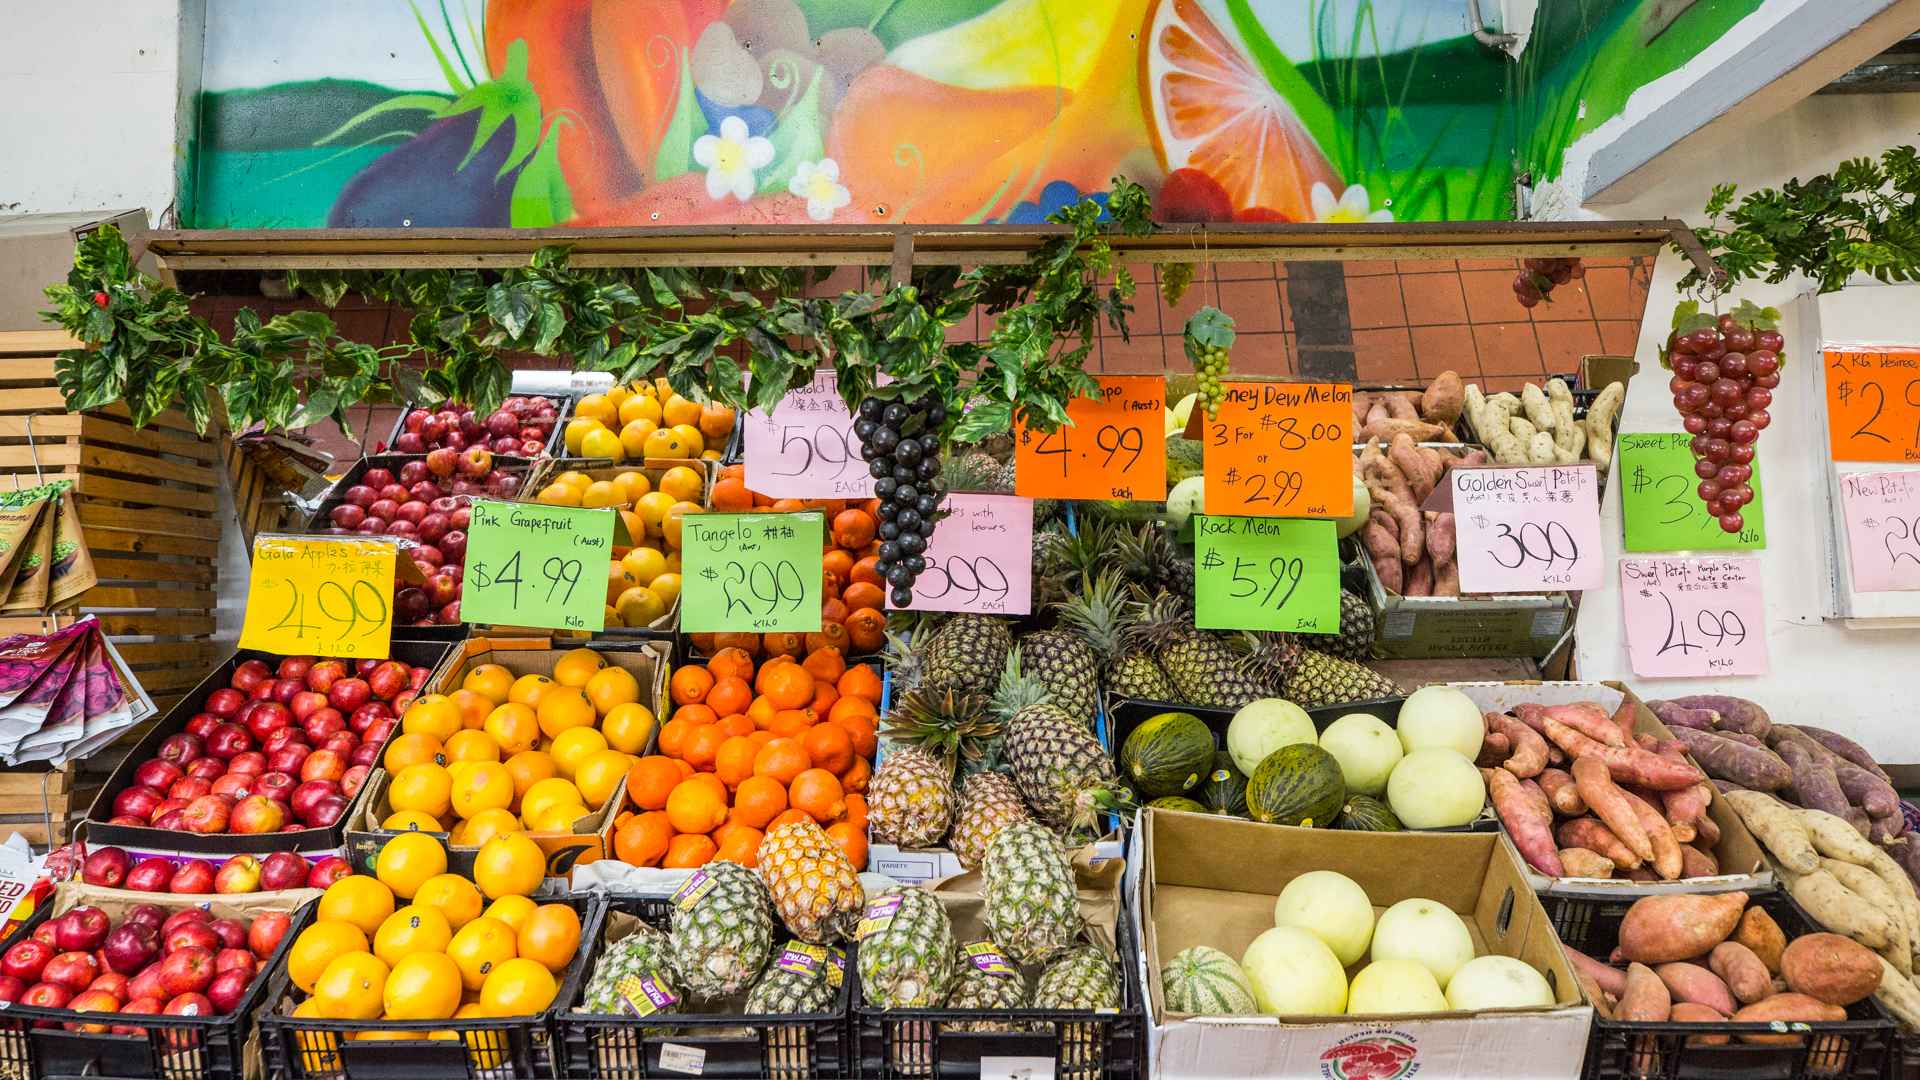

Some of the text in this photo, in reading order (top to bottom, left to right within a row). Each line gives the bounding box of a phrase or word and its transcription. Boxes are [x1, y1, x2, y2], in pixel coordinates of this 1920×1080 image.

[1832, 352, 1850, 373] 2
[1224, 385, 1350, 411] ney Dew Melon
[1212, 423, 1229, 446] 3
[1235, 427, 1254, 444] For
[1622, 435, 1665, 452] Sweet
[1257, 454, 1268, 463] or
[835, 481, 867, 496] EACH
[1458, 471, 1513, 492] Golden
[1552, 467, 1587, 490] Potato
[1112, 486, 1133, 499] Each
[474, 505, 501, 528] Pink
[972, 503, 994, 519] with
[688, 517, 752, 552] Tangelo
[1200, 516, 1281, 537] Rock Melon
[574, 535, 605, 548] (Aust)
[301, 543, 348, 568] Apples
[1625, 561, 1691, 583] Sweet Potato
[1697, 562, 1719, 573] Purple
[471, 550, 582, 609] $4.99
[1201, 546, 1303, 611] $5.99
[1543, 574, 1571, 584] KILO
[981, 601, 1005, 613] EACH
[1296, 617, 1317, 630] Each
[1709, 658, 1734, 668] KILO
